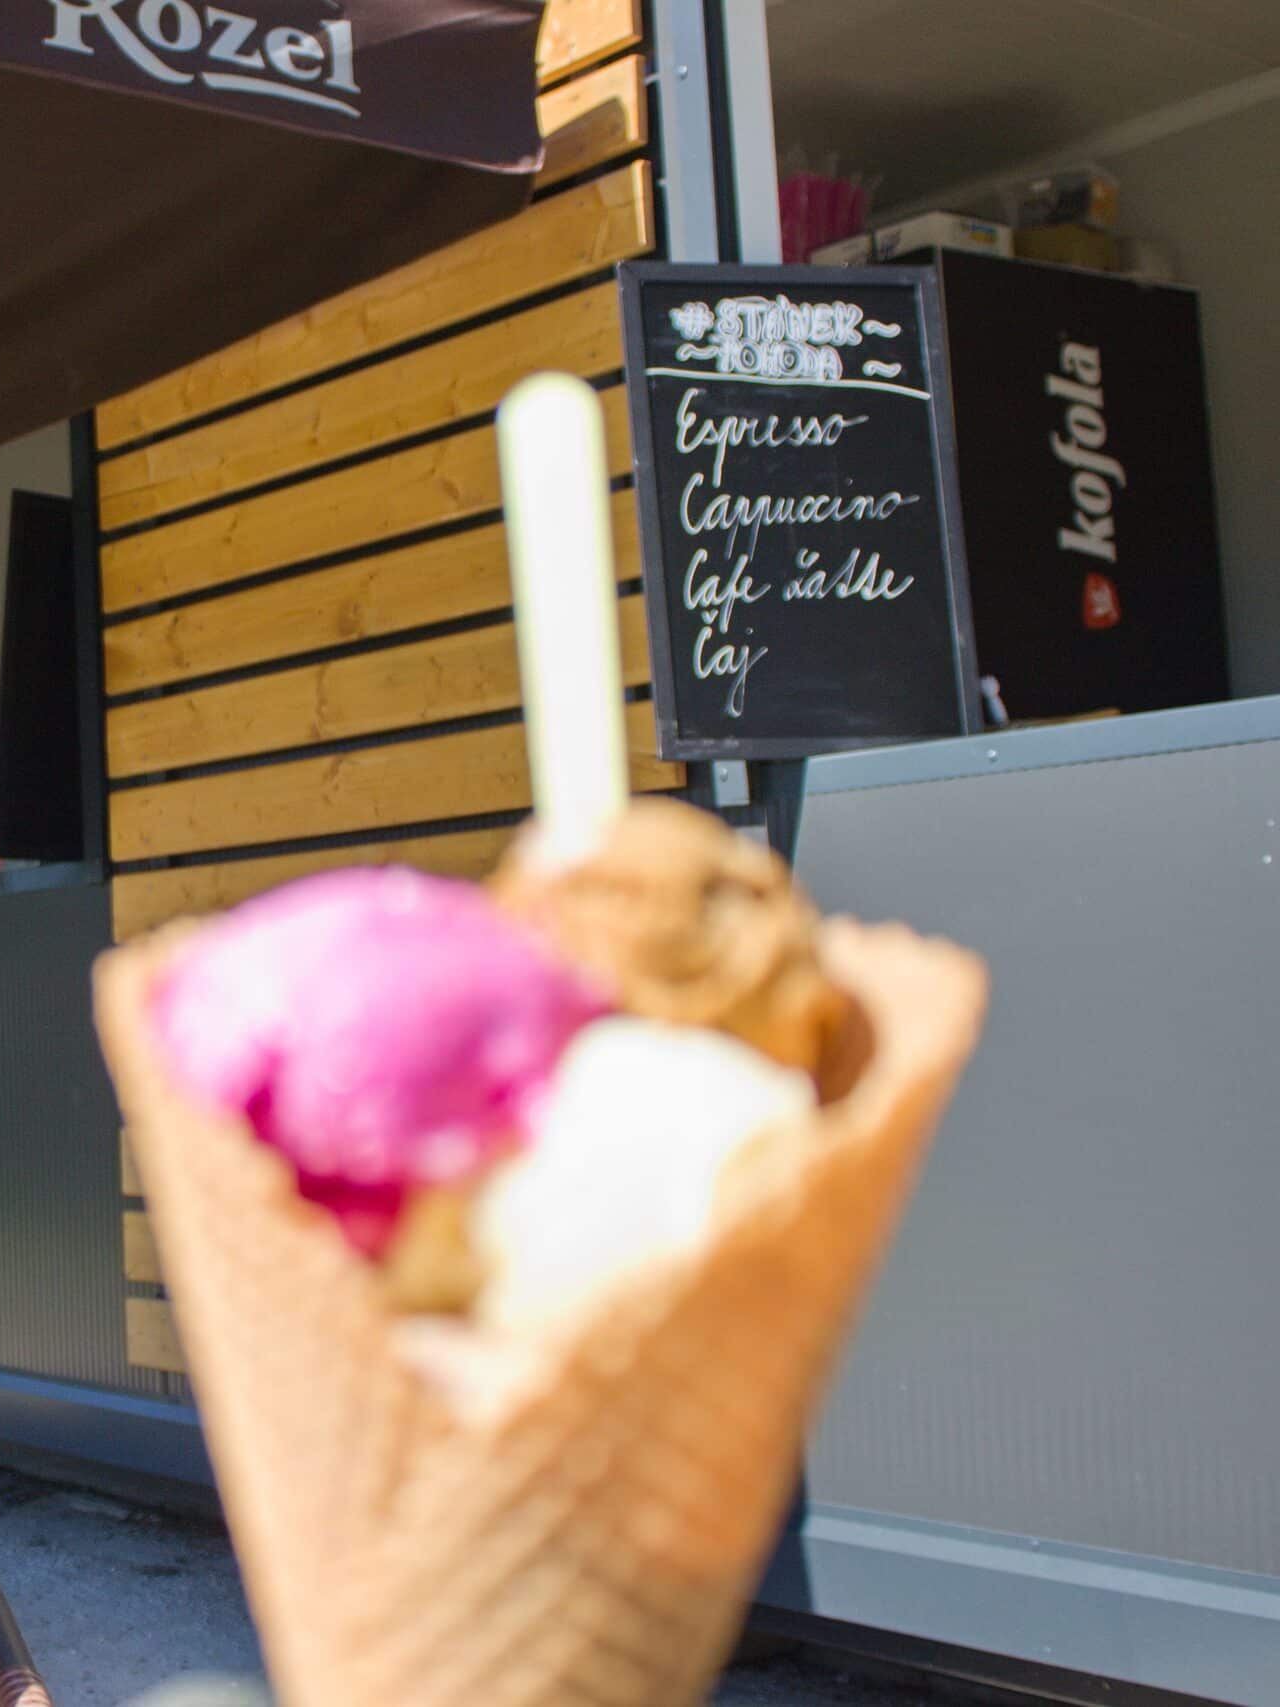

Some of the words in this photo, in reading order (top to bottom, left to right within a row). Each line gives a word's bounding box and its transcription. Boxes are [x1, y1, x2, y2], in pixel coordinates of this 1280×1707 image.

[676, 387, 869, 487] Espresso
[1046, 342, 1126, 563] kofola
[680, 472, 920, 560] Cappuccino
[693, 610, 768, 717] Čaj
